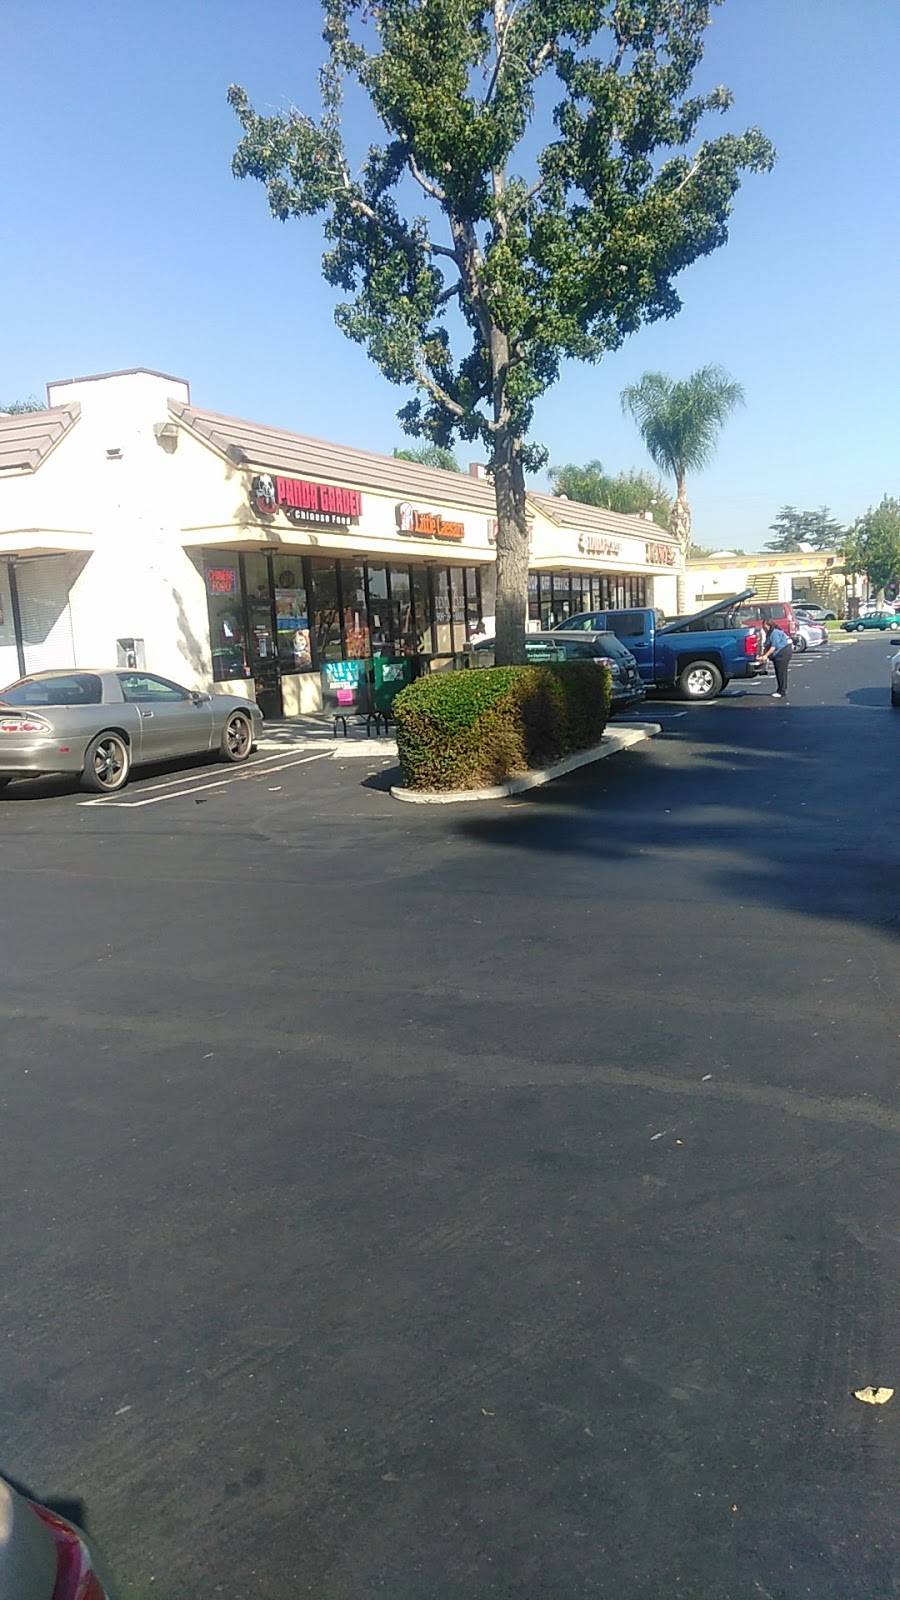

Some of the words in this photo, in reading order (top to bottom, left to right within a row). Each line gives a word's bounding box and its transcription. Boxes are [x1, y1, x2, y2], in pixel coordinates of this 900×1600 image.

[276, 475, 319, 511] PANDA
[320, 484, 362, 516] GARDEN
[414, 511, 437, 534] Little
